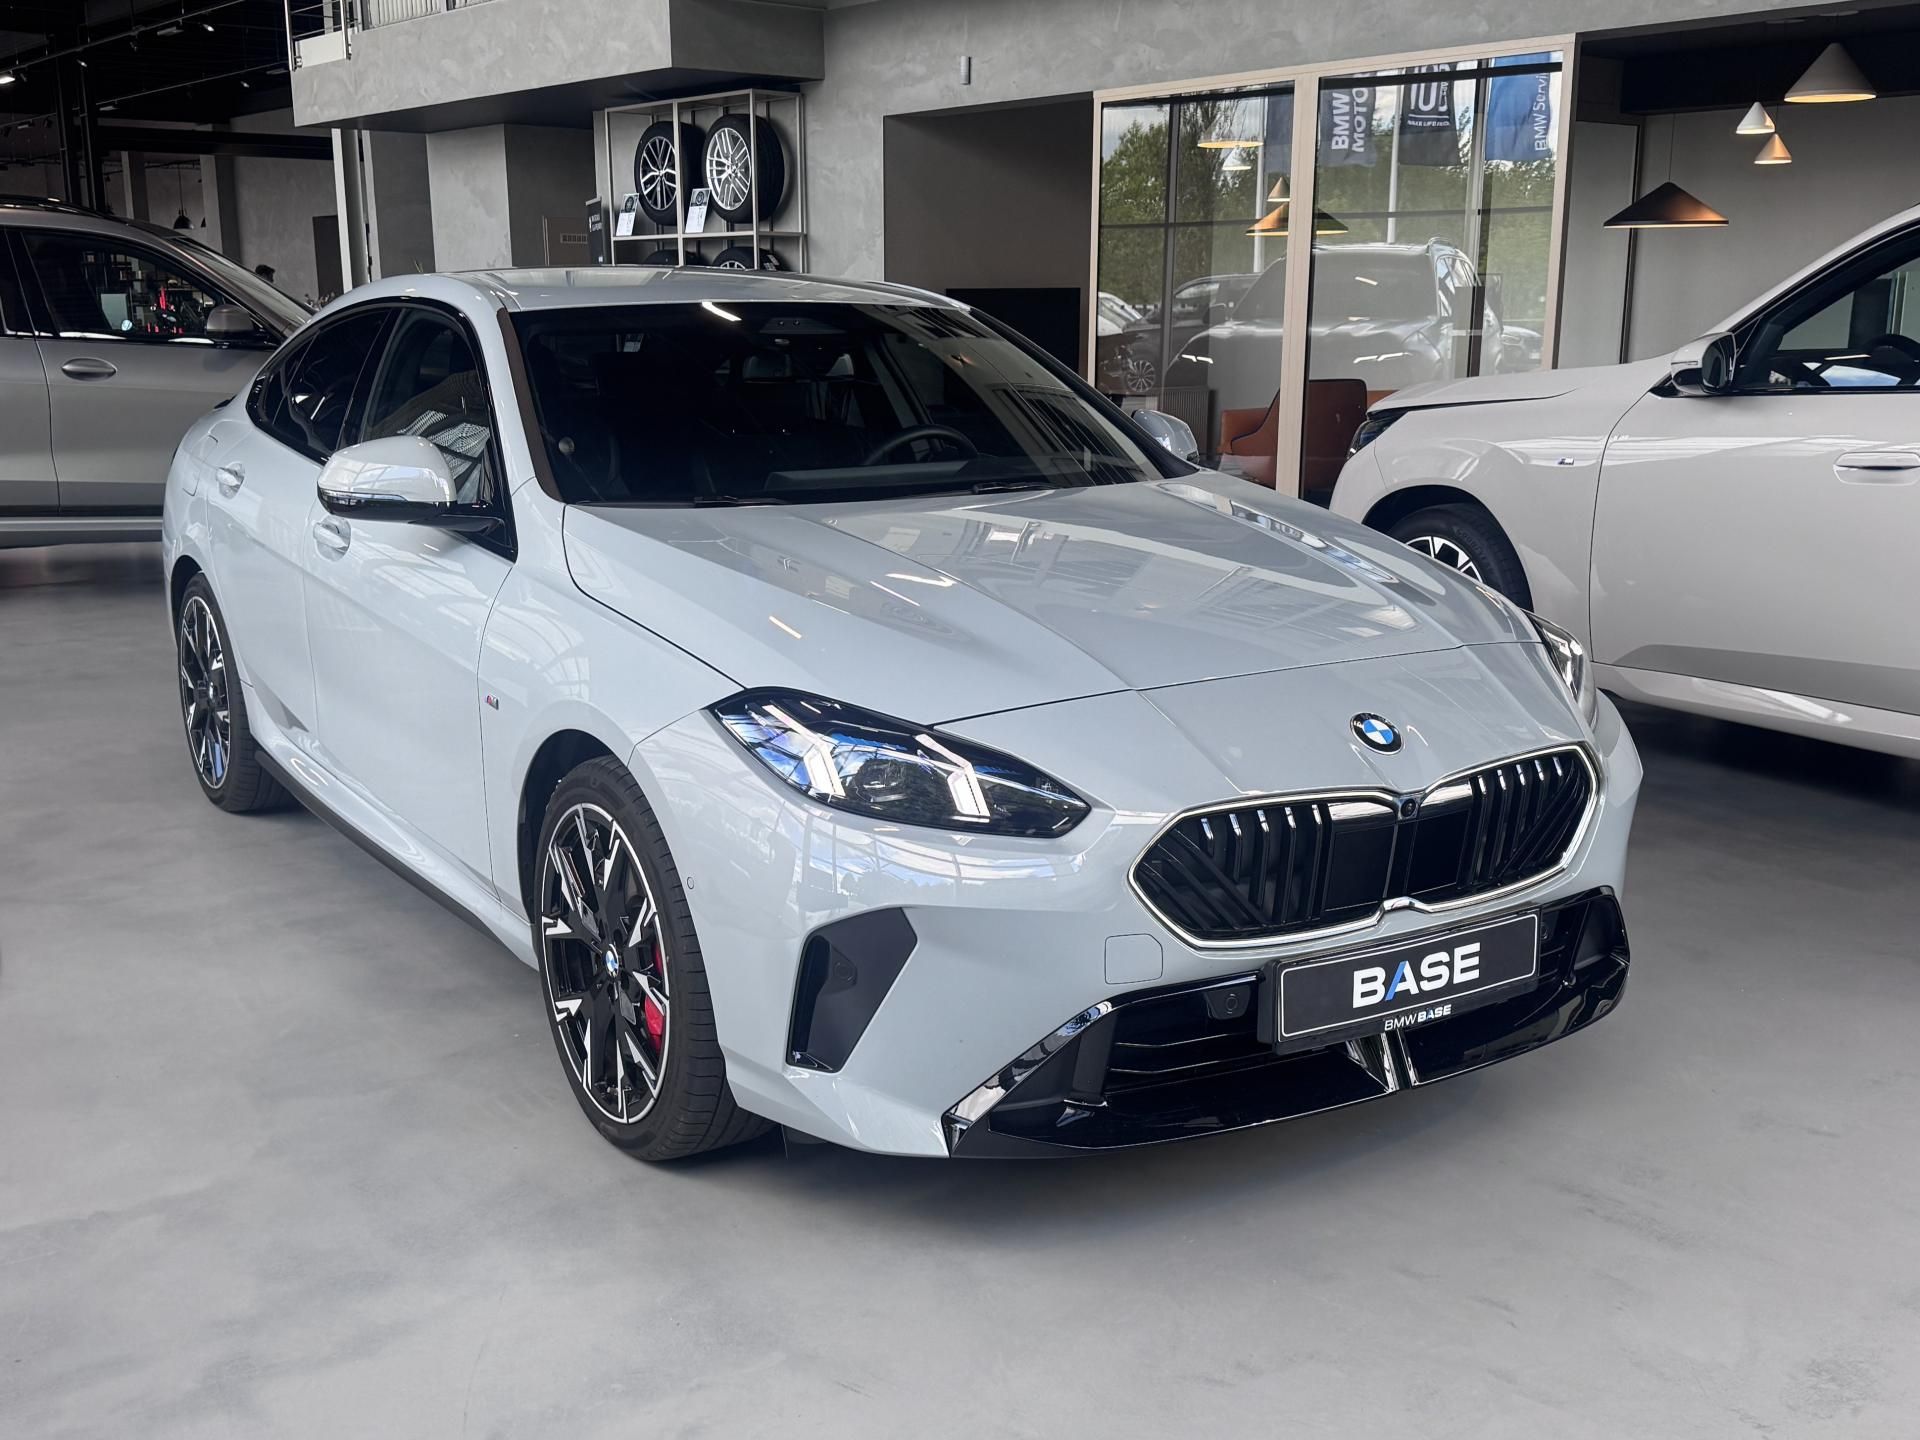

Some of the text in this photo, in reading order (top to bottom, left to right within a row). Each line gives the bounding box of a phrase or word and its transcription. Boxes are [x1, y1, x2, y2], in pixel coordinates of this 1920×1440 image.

[1331, 92, 1351, 150] BMW
[1351, 74, 1369, 153] MOTO
[1532, 72, 1551, 151] BMW Servi
[1352, 942, 1481, 1009] BASE
